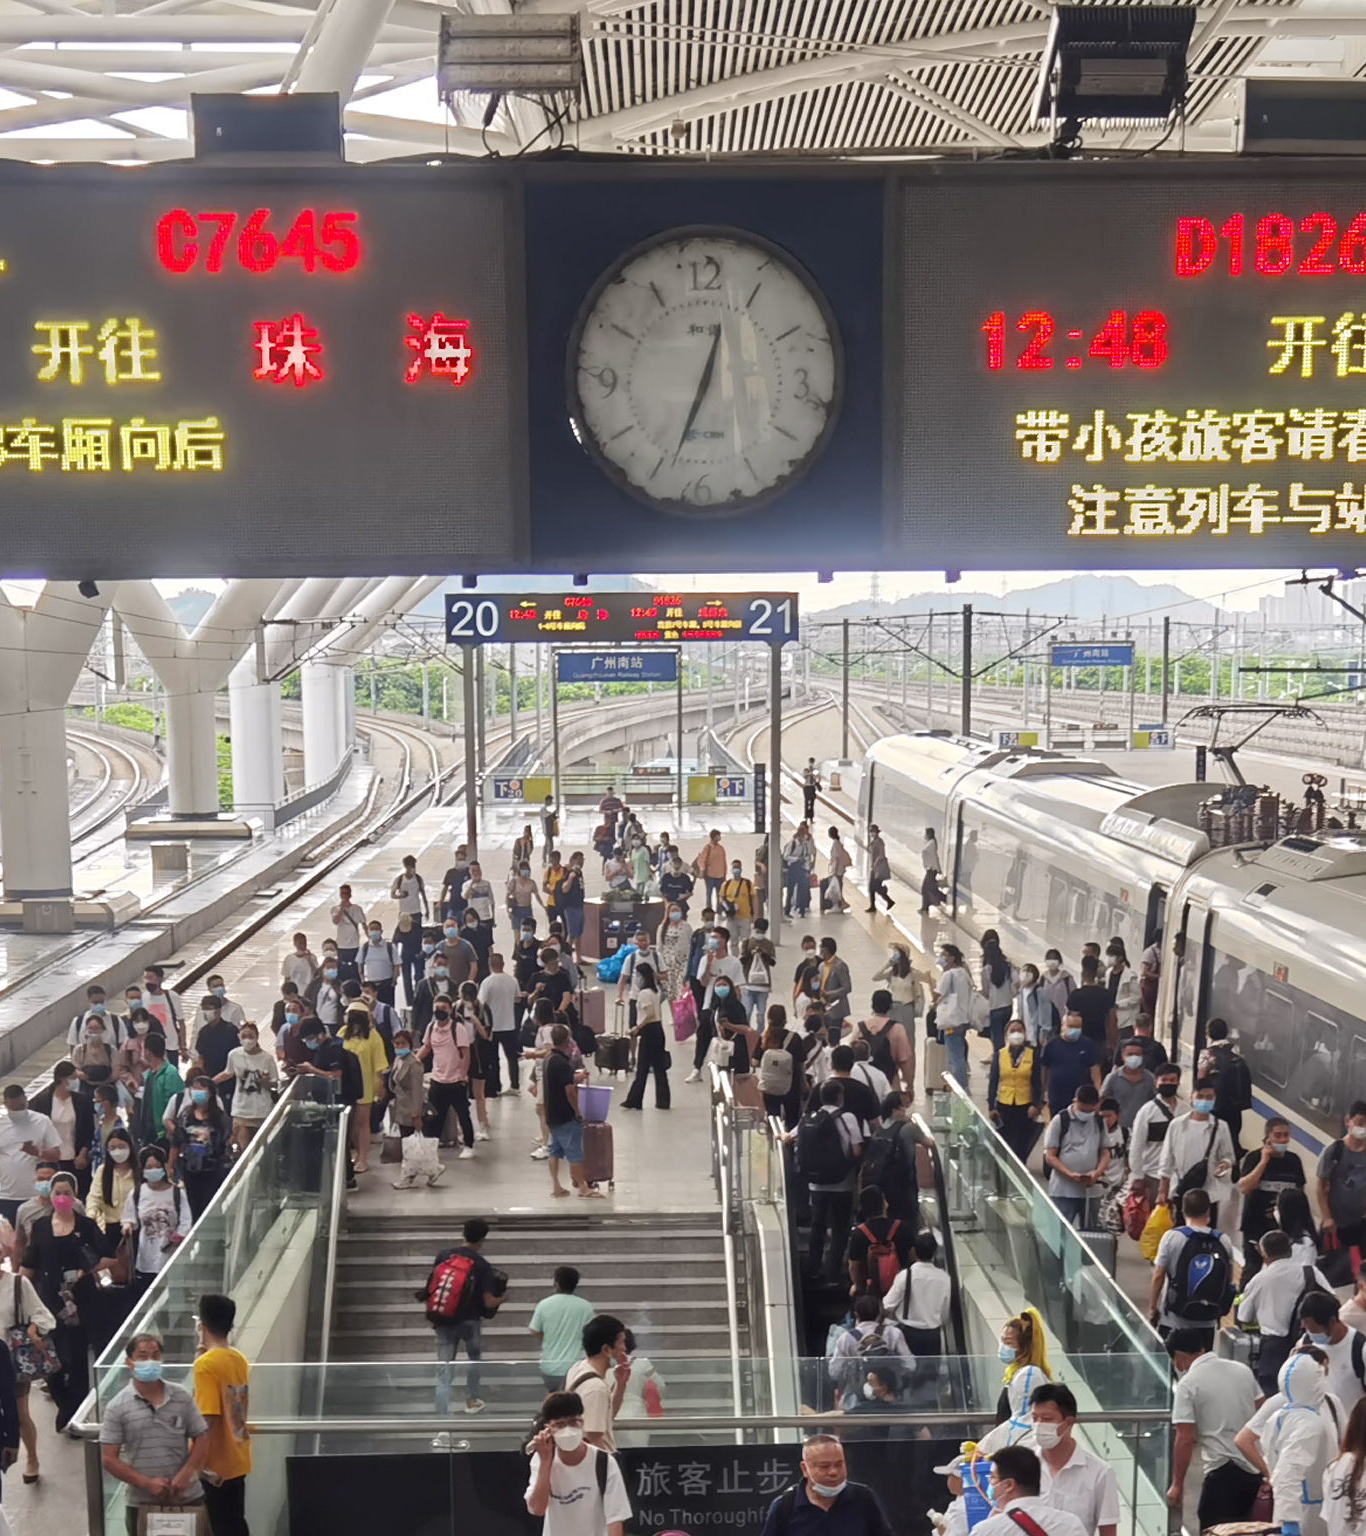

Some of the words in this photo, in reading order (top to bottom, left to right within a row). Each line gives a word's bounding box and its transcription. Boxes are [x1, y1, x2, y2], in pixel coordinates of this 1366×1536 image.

[155, 207, 361, 274] C7645
[688, 257, 722, 291] 12
[31, 317, 161, 385] 开往
[251, 312, 323, 387] 珠
[403, 312, 473, 387] 海
[979, 310, 1170, 373] 12:48
[598, 368, 617, 399] 9
[793, 368, 810, 399] 3
[693, 473, 712, 501] 6
[450, 600, 500, 636] 20
[748, 599, 791, 634] 21
[591, 656, 643, 671] 广州南站
[496, 779, 508, 798] 下
[636, 1458, 793, 1497] 旅客止步
[639, 1509, 665, 1526] No
[670, 1507, 771, 1527] Thoroughf
